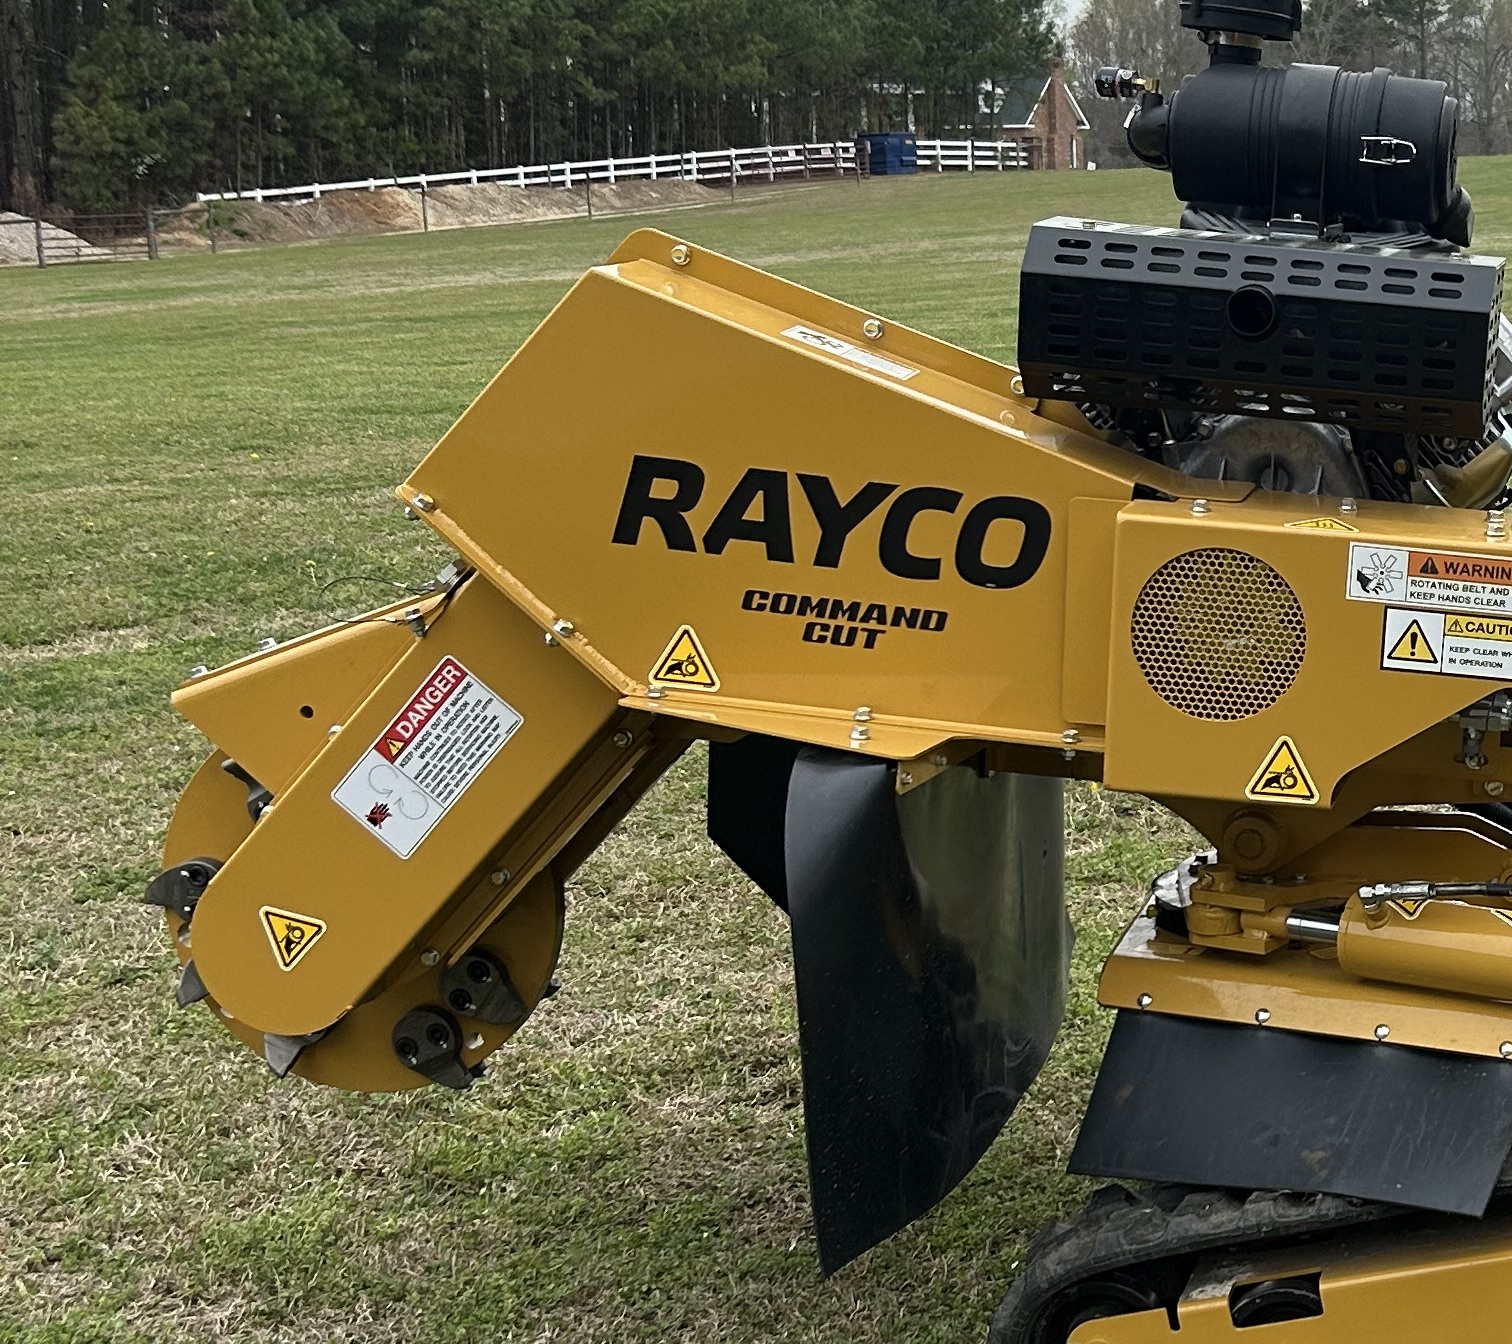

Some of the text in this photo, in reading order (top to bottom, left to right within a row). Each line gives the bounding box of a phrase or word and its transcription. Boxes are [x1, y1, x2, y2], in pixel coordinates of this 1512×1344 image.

[612, 455, 1052, 589] RAYCO
[1409, 591, 1506, 608] KEEP HANDS CLEAR
[1410, 579, 1460, 592] ROTATING
[1462, 583, 1487, 595] BELT
[1489, 585, 1510, 596] AND
[741, 589, 948, 633] COMMAND
[802, 621, 887, 649] CUT
[1449, 645, 1470, 654] KEEP
[1473, 648, 1499, 656] CLEAR
[1448, 657, 1503, 668] IN OPERATION
[394, 663, 461, 739] DANGER
[412, 729, 432, 751] HANDS
[429, 716, 443, 730] OUT
[441, 706, 451, 717] OF
[440, 700, 470, 734] OPERATION
